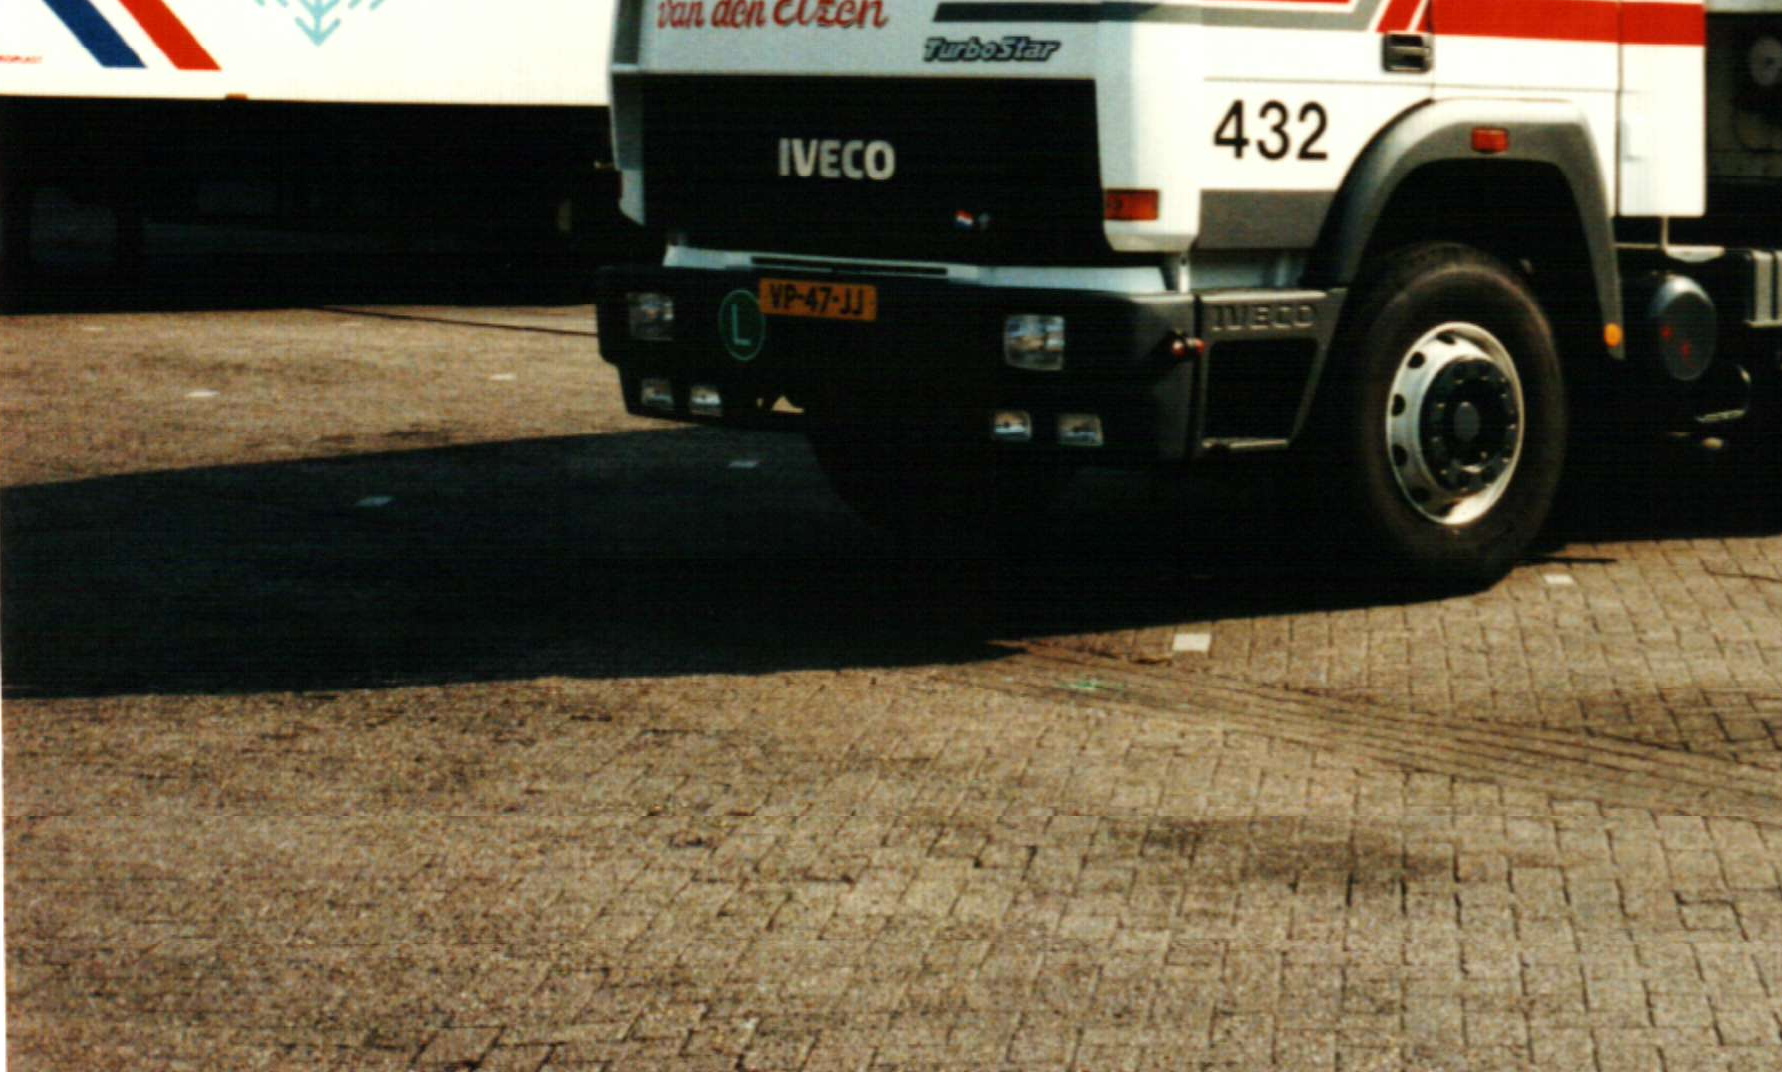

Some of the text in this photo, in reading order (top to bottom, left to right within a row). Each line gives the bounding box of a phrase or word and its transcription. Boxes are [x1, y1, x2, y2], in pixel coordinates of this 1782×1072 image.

[923, 36, 1062, 62] TurboStar
[1213, 100, 1329, 161] 432
[778, 138, 896, 180] IVECO
[769, 283, 866, 316] VP-47-JJ
[1210, 304, 1316, 330] IVECO
[731, 303, 752, 346] L
